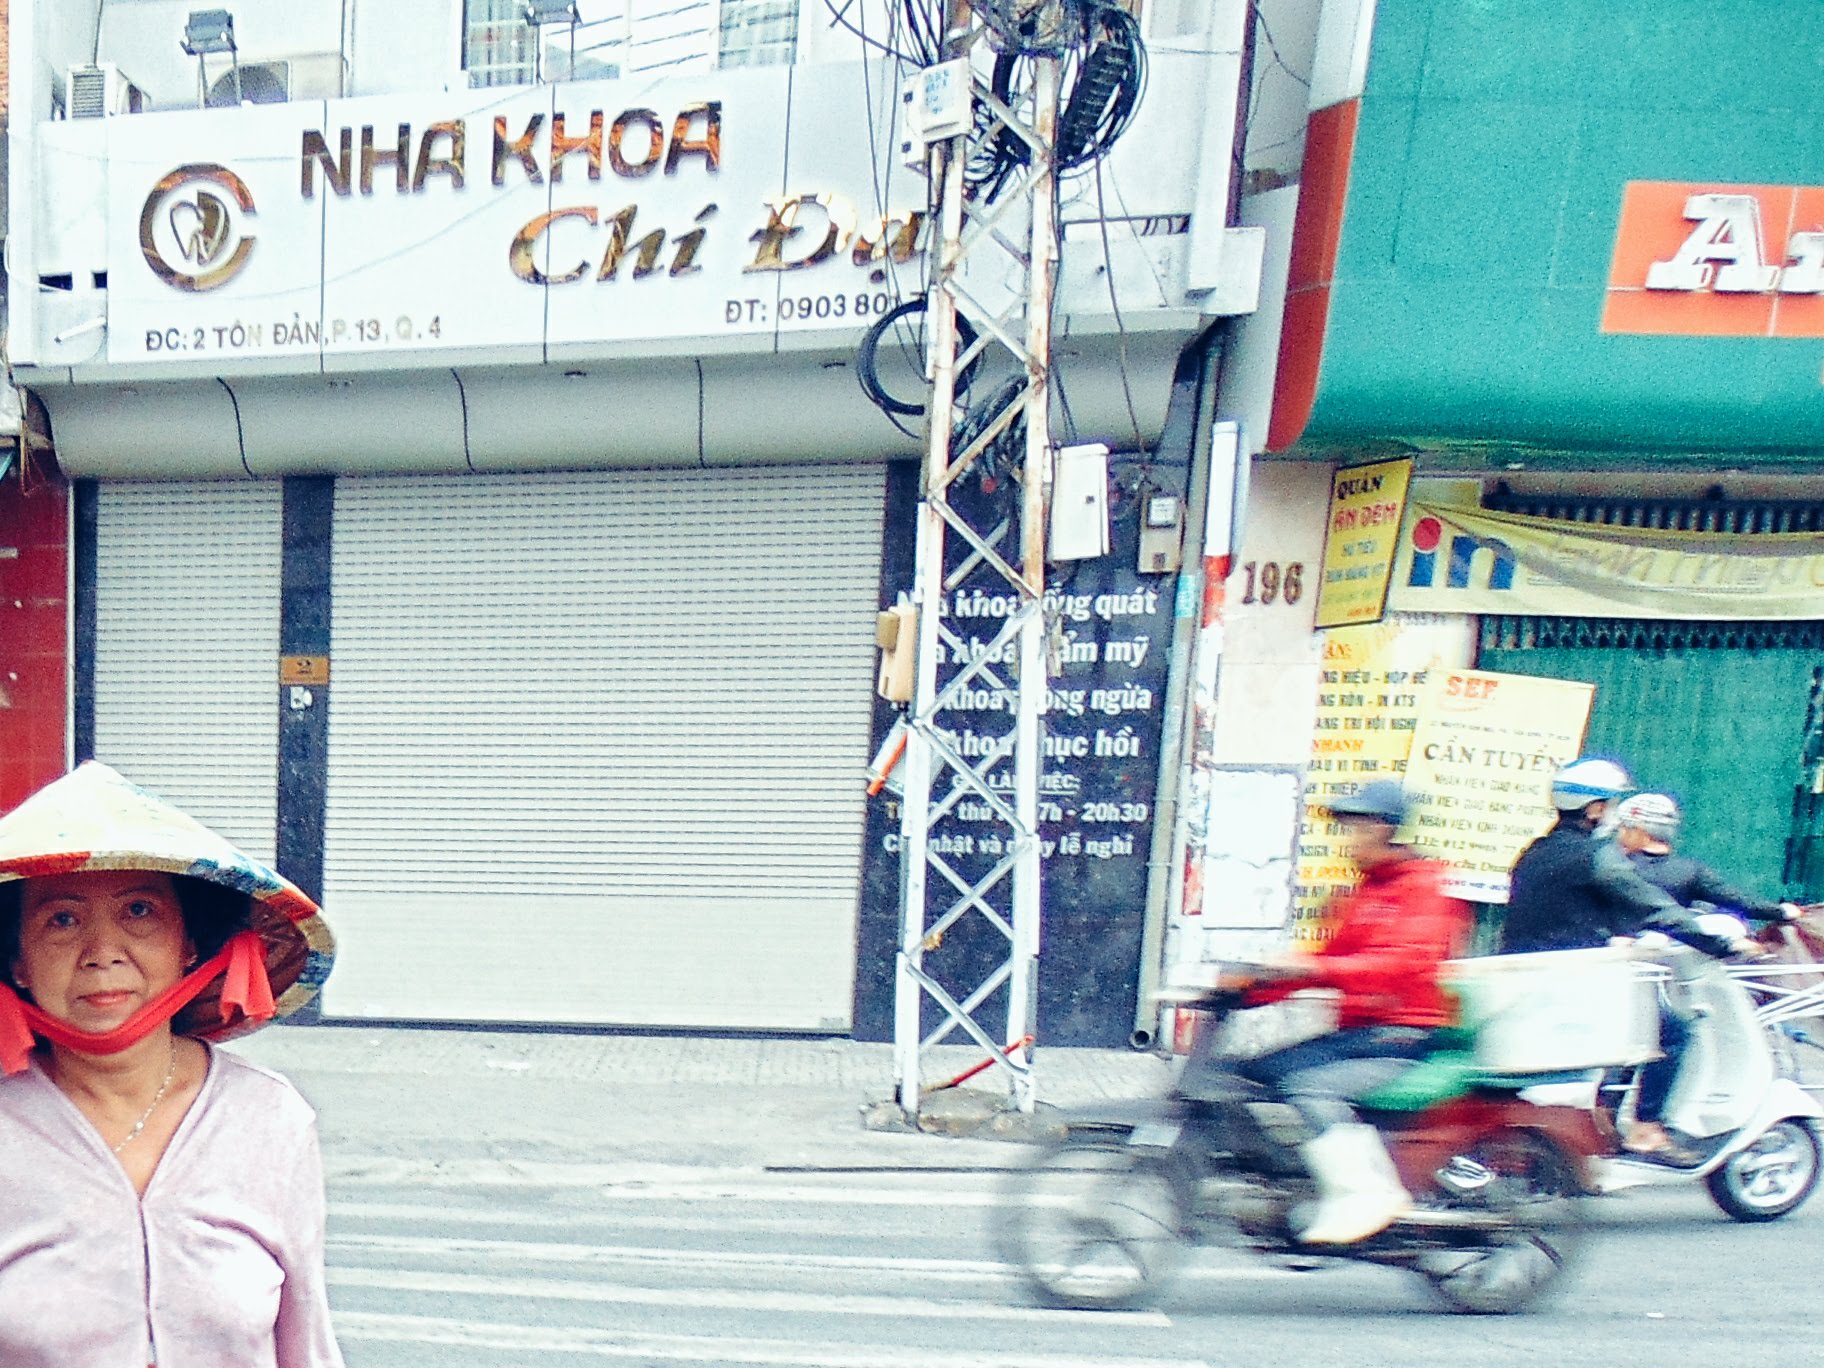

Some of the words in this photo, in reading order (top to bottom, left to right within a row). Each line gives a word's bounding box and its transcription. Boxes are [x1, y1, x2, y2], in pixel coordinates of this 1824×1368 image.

[300, 117, 467, 198] NHA
[491, 99, 723, 187] KHOA
[508, 202, 721, 286] Chí
[725, 300, 767, 324] ĐT:
[212, 320, 263, 349] TÔN
[1241, 560, 1305, 606] 196
[1095, 586, 1158, 620] quát
[1104, 635, 1150, 668] mỹ
[1095, 726, 1140, 757] hồi
[1080, 801, 1149, 823] 20h30
[978, 836, 1003, 854] và
[1059, 832, 1082, 855] lễ
